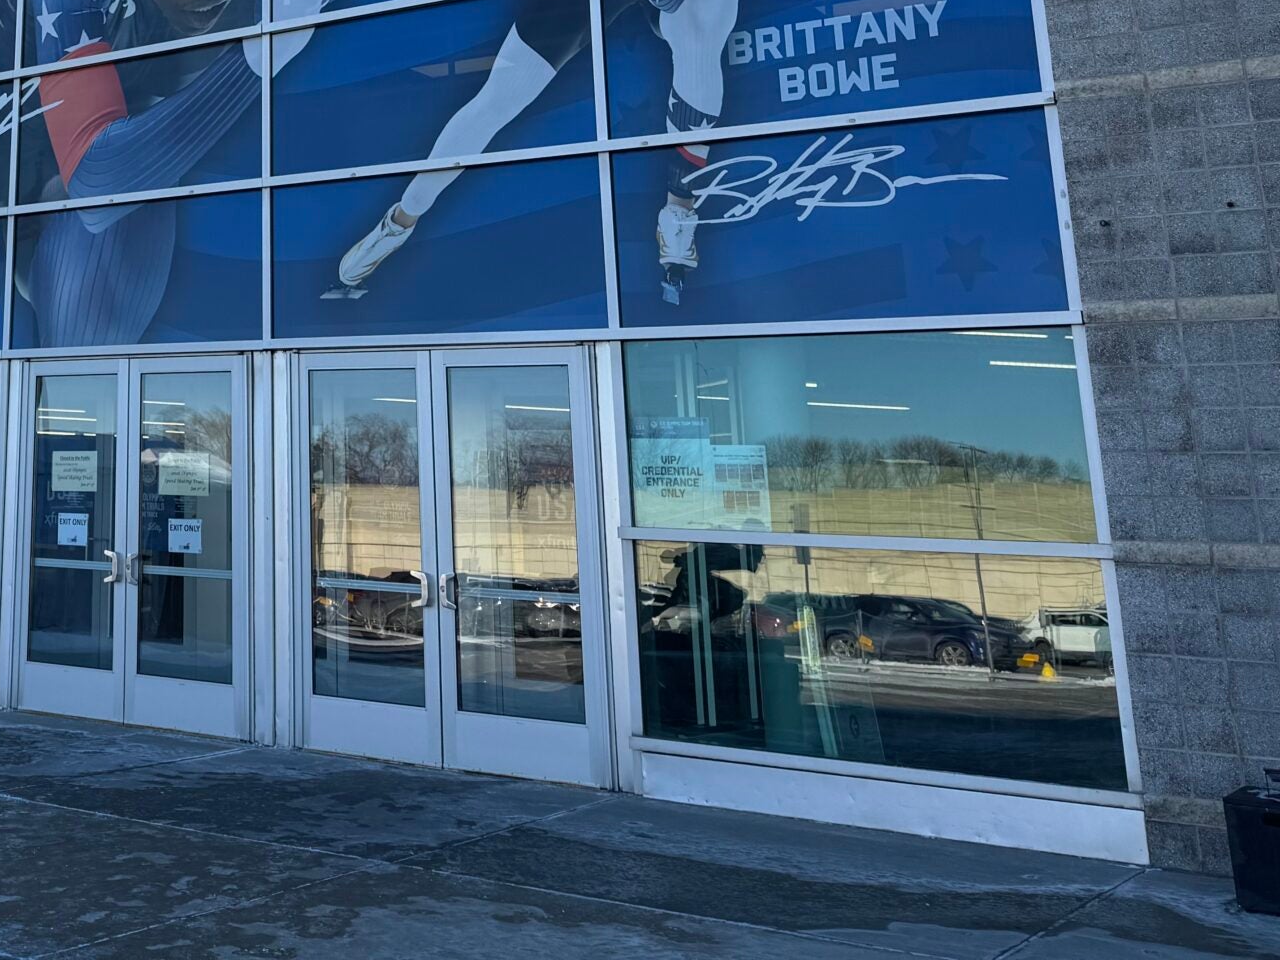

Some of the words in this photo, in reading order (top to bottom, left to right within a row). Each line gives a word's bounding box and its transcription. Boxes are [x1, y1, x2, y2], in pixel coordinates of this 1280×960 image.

[727, 0, 948, 66] BRITTANY
[778, 52, 900, 102] BOWE
[660, 455, 681, 465] VIP/
[641, 466, 704, 476] CREDENTIAL
[646, 477, 700, 487] ENTRANCE
[661, 488, 686, 498] ONLY
[59, 518, 71, 526] EXIT
[72, 518, 86, 526] ONLY
[169, 524, 183, 532] EXIT
[183, 524, 200, 533] ONLY
